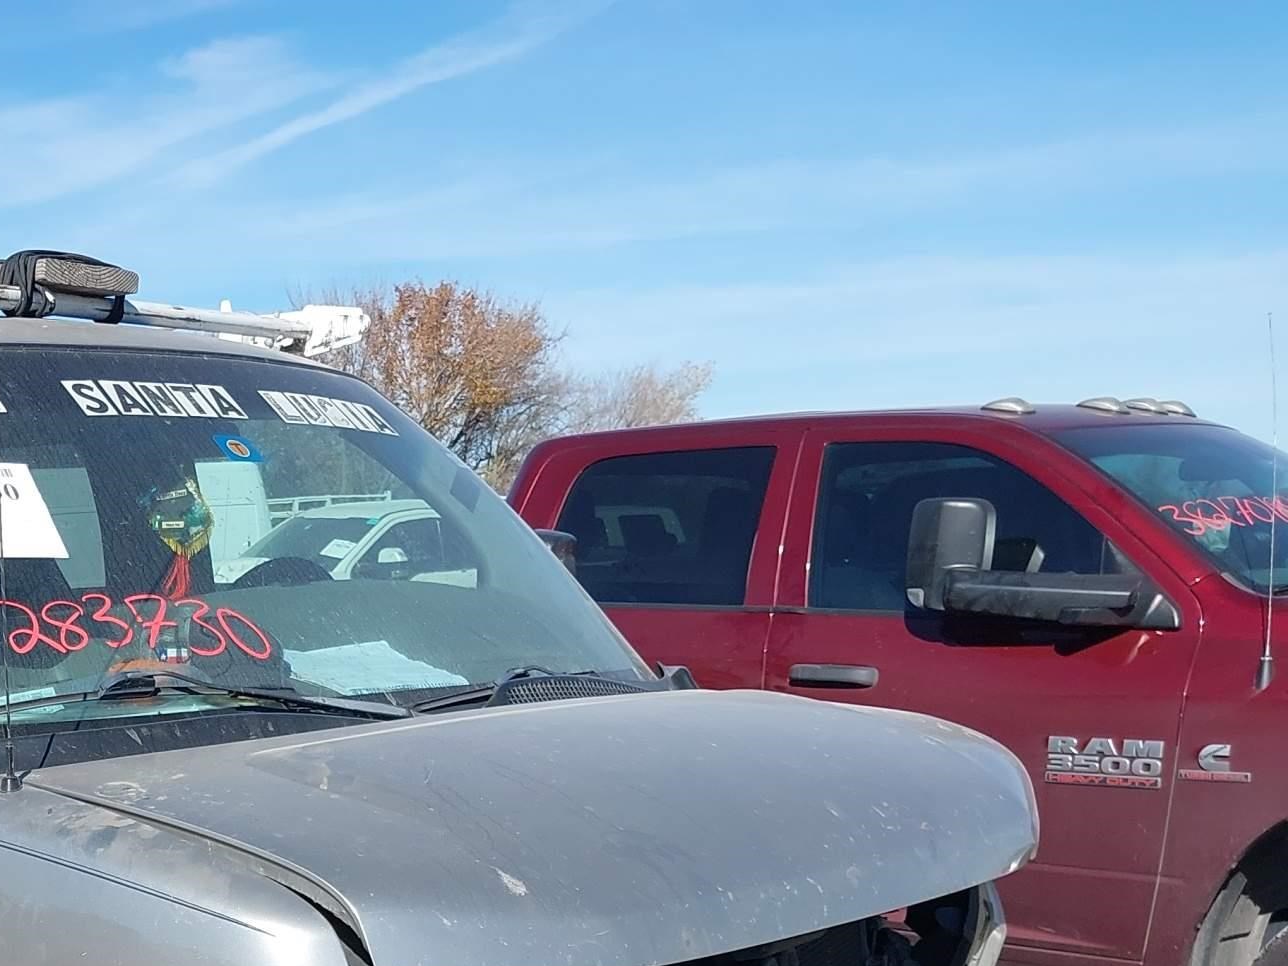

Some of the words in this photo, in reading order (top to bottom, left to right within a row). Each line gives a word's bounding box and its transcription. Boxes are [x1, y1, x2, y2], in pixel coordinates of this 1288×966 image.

[69, 382, 247, 417] SANTA
[1047, 735, 1164, 758] RAM
[1046, 753, 1162, 776] 3500
[1048, 772, 1103, 784] HEAVY
[1106, 777, 1156, 786] DUTY
